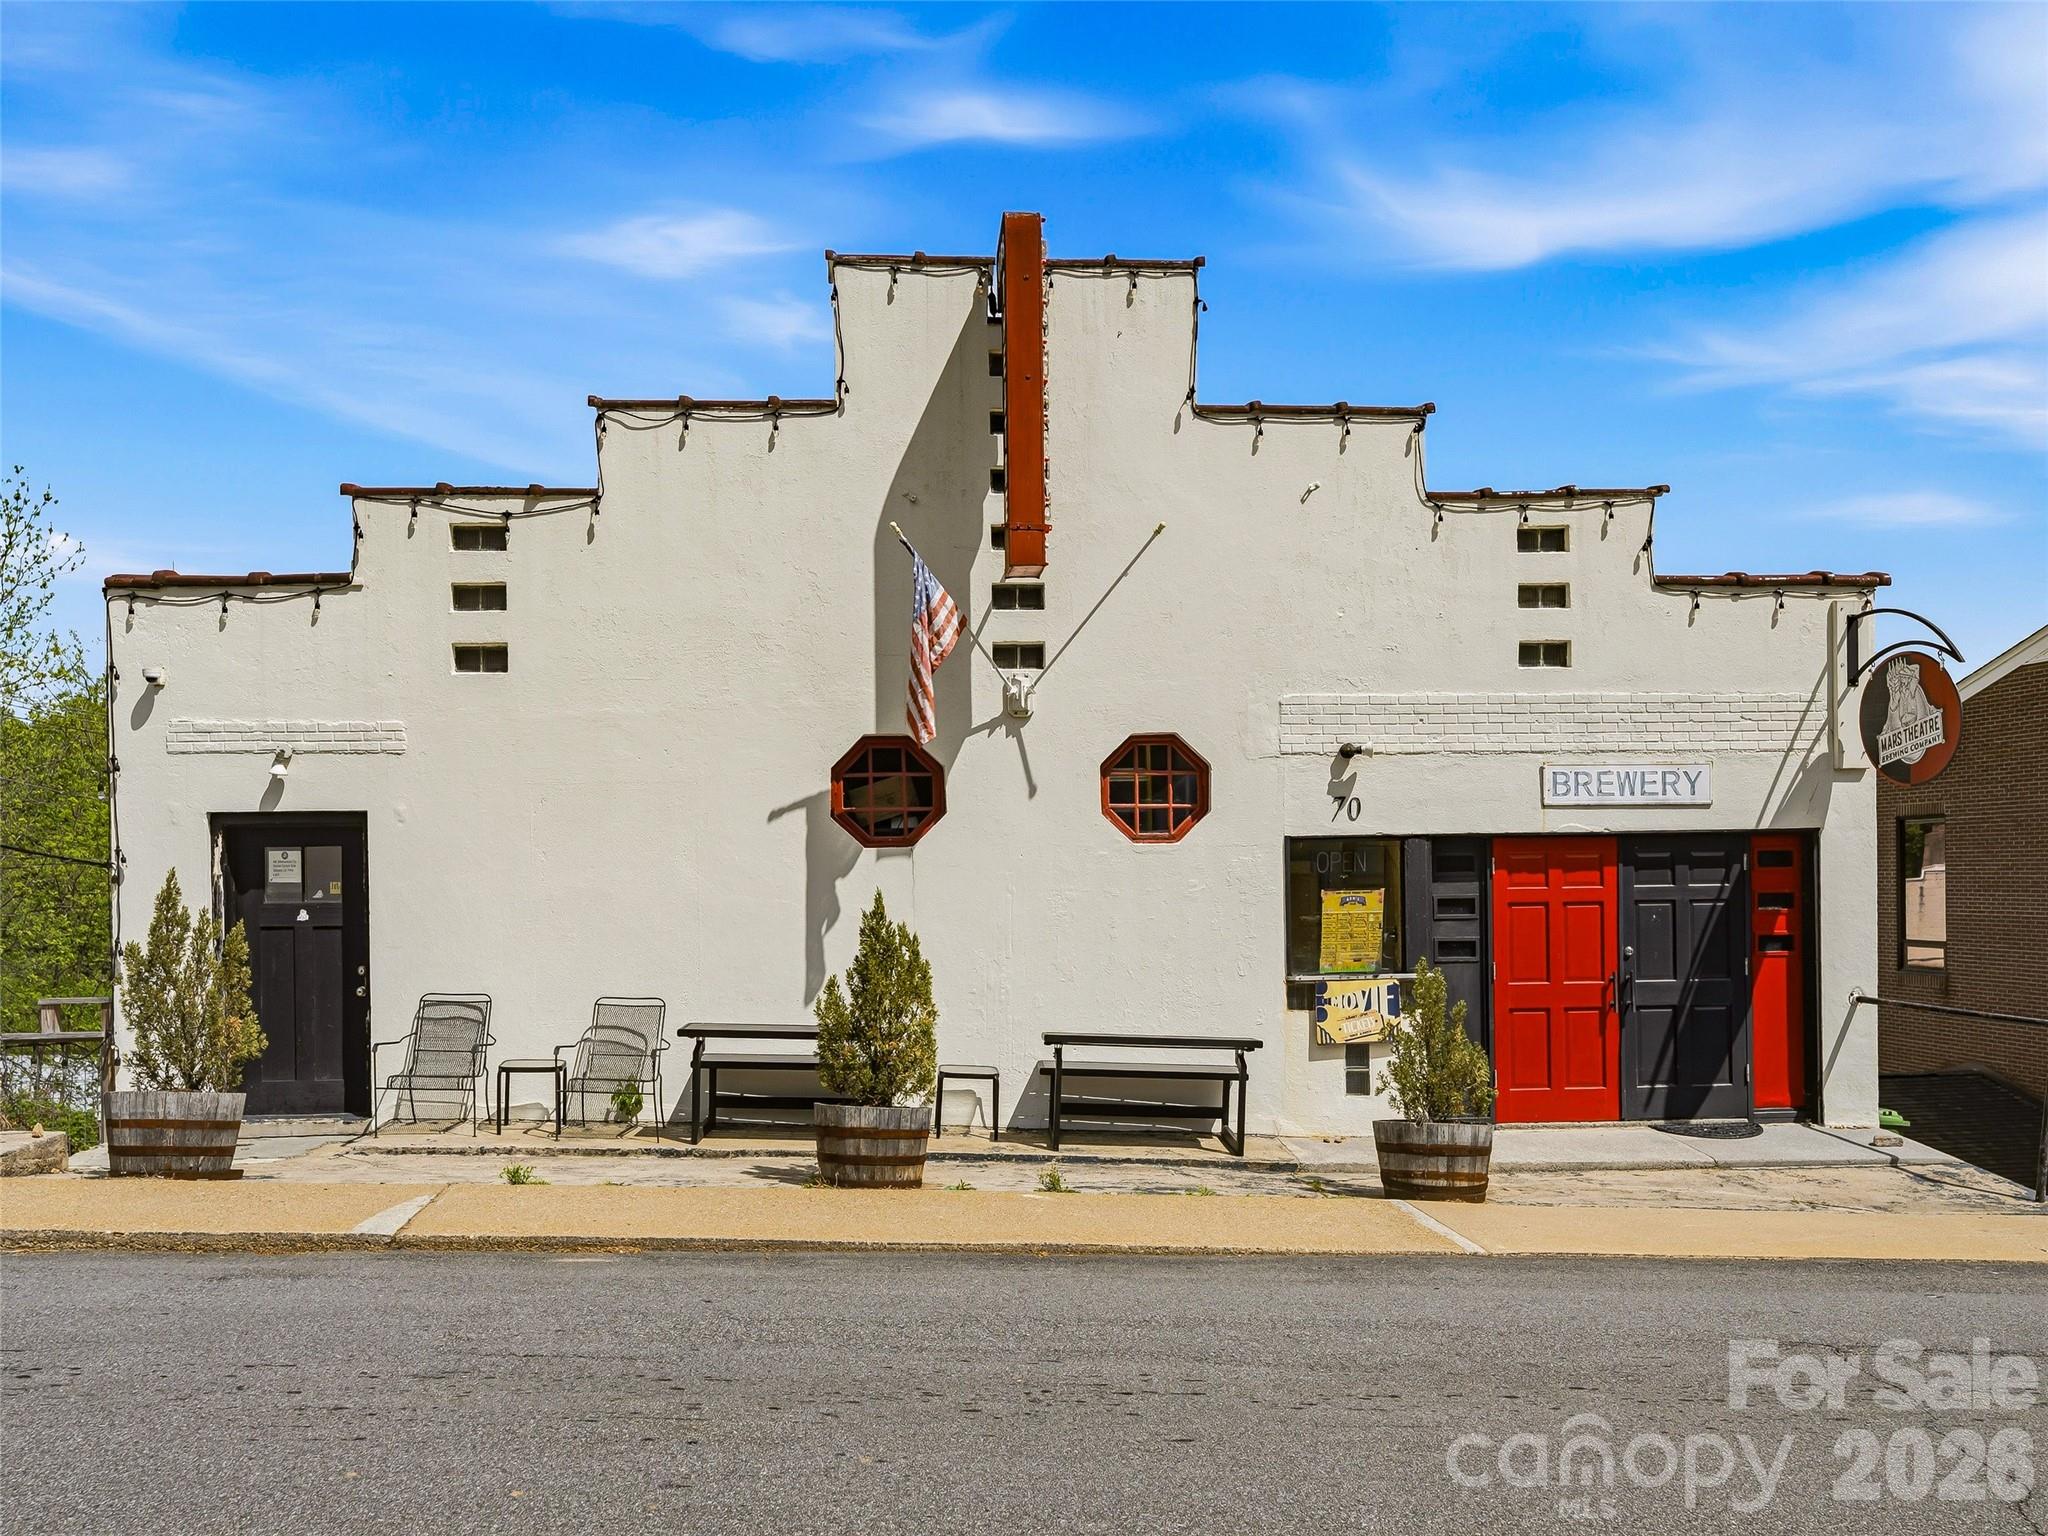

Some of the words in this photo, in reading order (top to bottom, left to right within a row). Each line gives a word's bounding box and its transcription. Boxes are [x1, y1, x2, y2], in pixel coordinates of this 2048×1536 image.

[1880, 731, 1902, 752] MARS
[1903, 715, 1940, 743] THEATRE
[1881, 746, 1909, 763] BREWING
[1910, 734, 1941, 752] COMPANY
[1551, 770, 1703, 797] BREWERY
[1331, 796, 1362, 823] 70
[1316, 850, 1368, 874] OPEN
